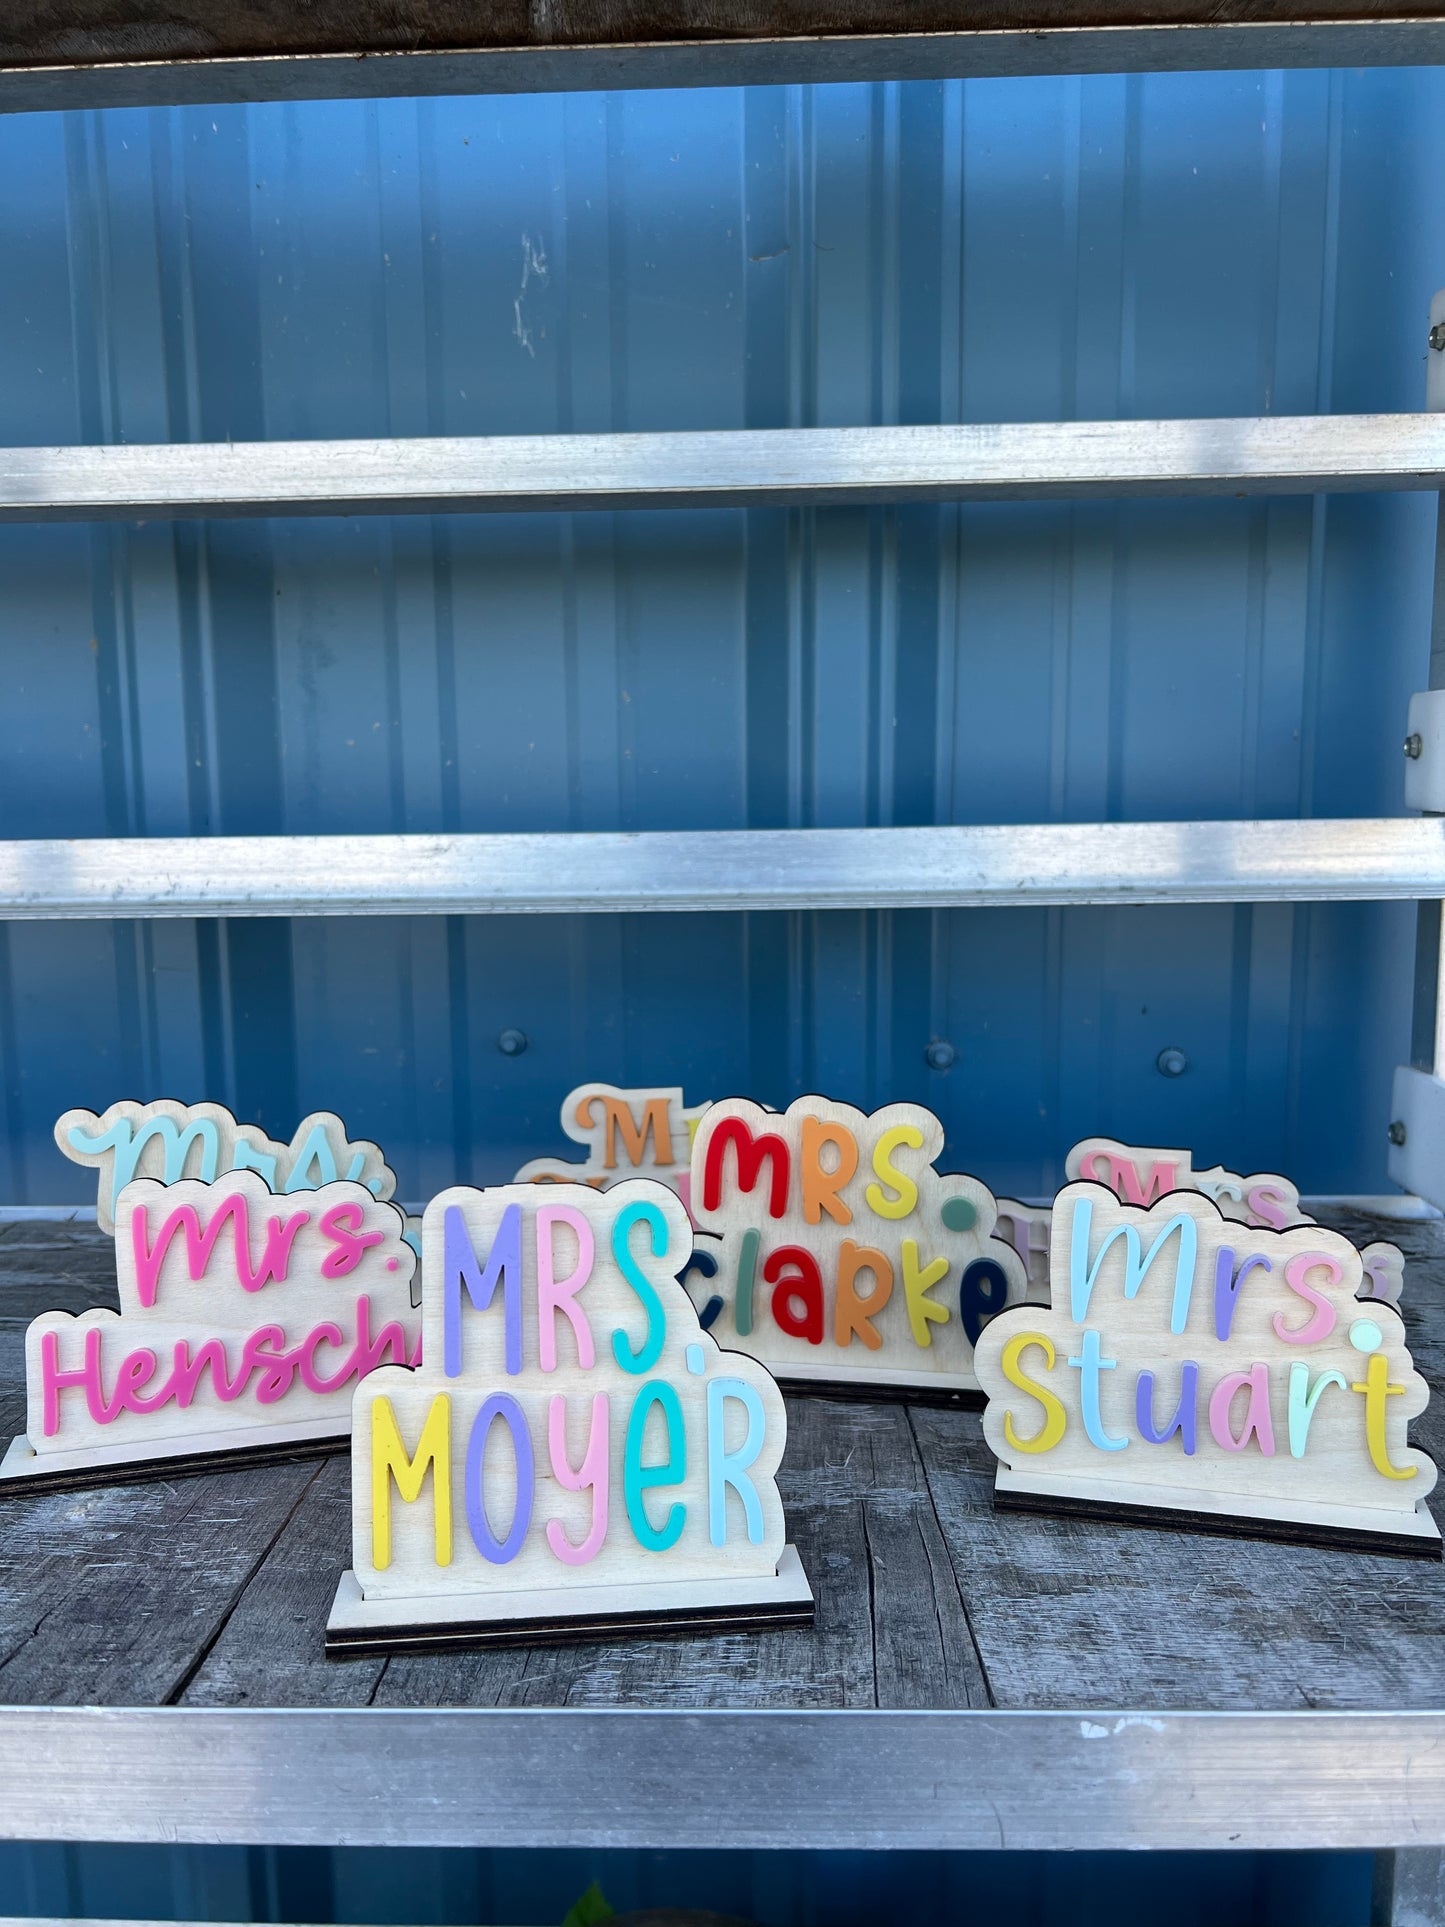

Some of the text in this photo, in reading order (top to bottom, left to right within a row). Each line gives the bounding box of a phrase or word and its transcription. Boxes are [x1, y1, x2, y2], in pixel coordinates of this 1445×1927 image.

[132, 1192, 398, 1308] Mrs.
[443, 1200, 705, 1378] MRS.
[1070, 1197, 1383, 1352] Mrs.
[41, 1294, 422, 1436] Hensch
[1001, 1330, 1418, 1480] Stuart
